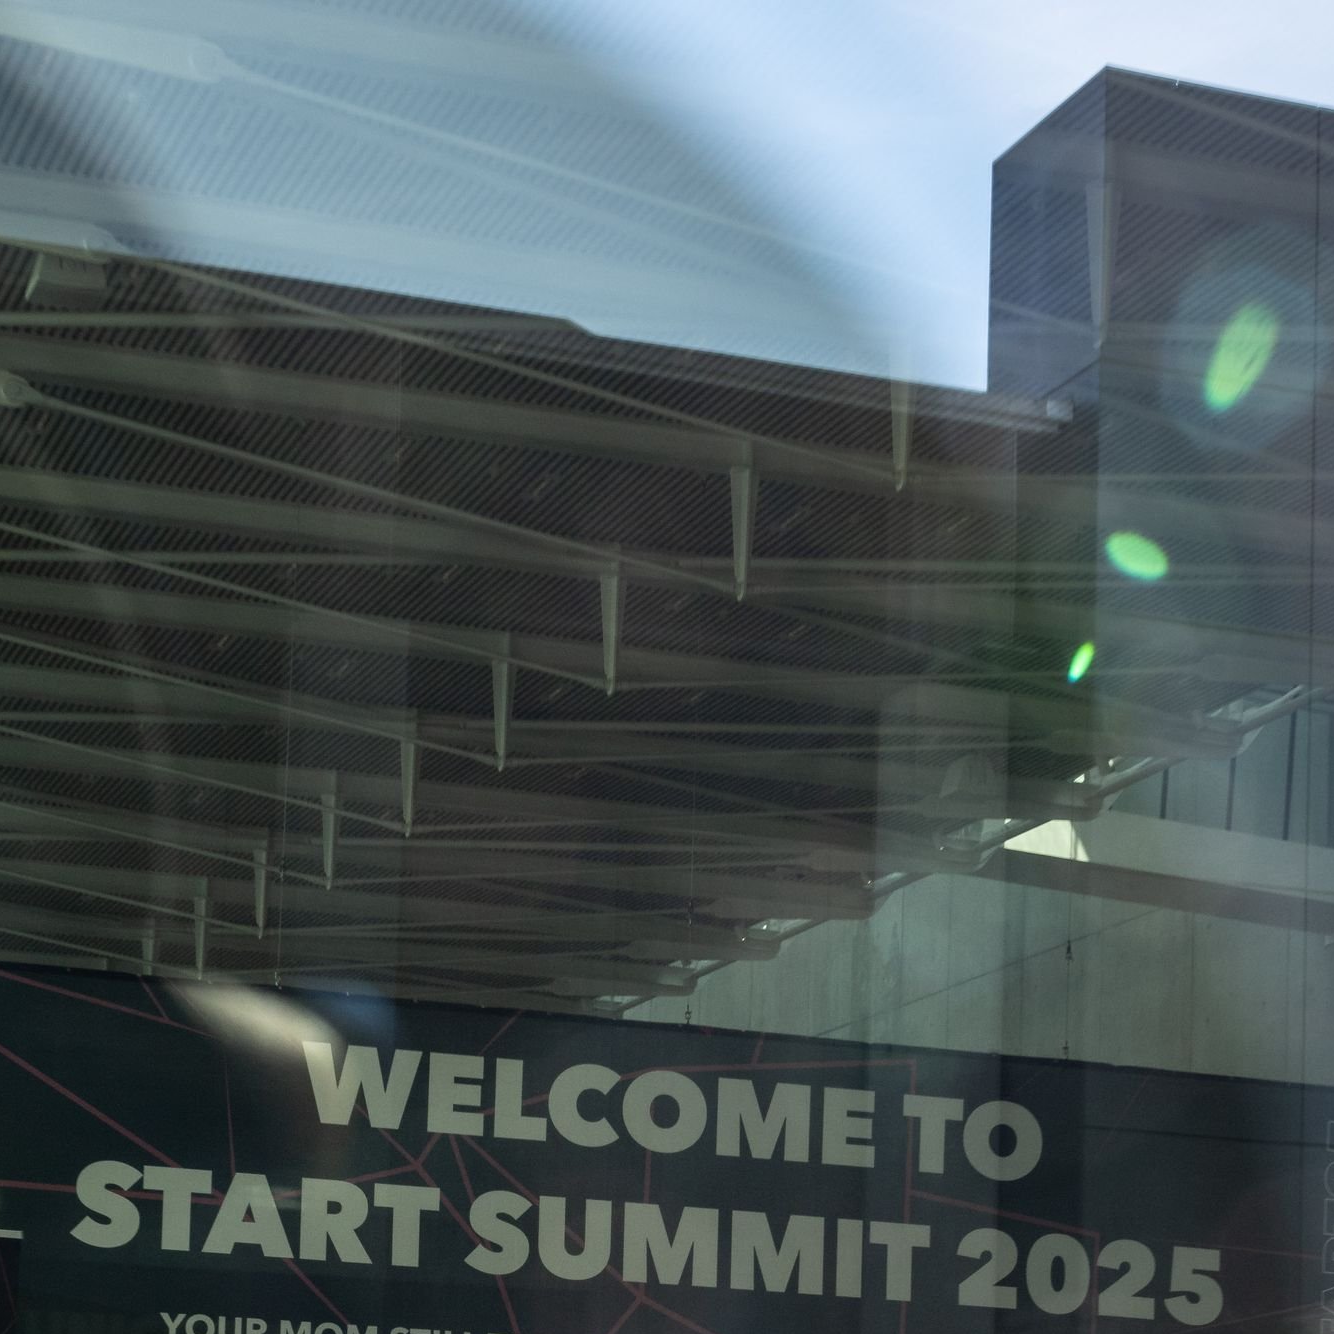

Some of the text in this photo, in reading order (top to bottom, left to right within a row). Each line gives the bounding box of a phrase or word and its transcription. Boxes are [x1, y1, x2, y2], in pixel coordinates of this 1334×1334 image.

[300, 1039, 1042, 1180] WELCOME TO
[70, 1161, 1223, 1325] START SUMMIT 2025
